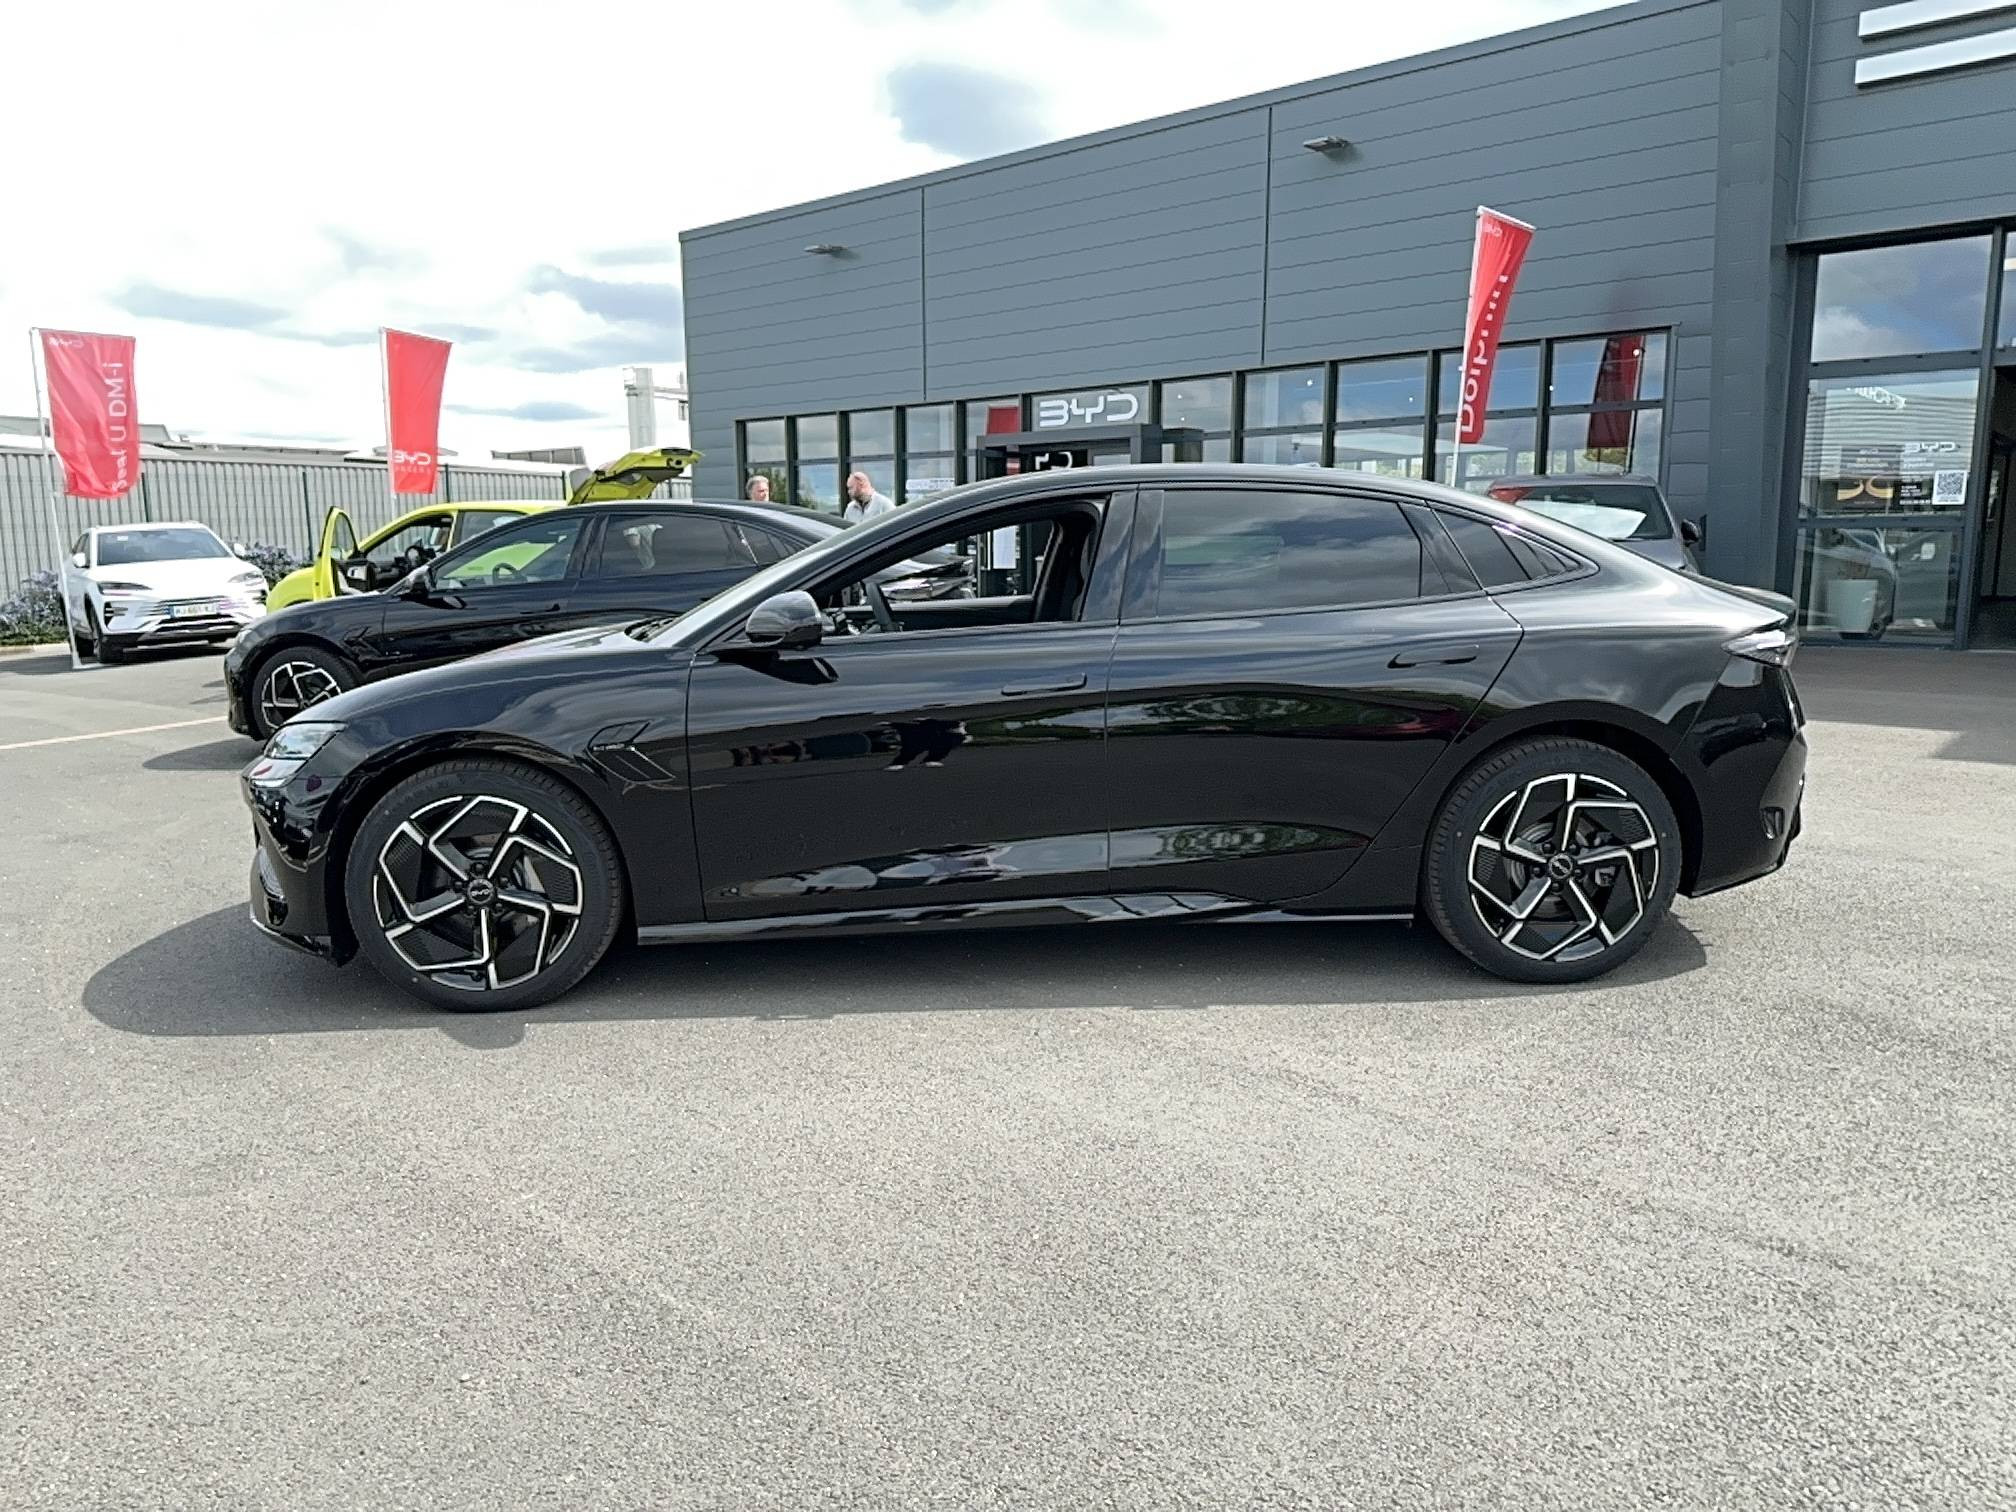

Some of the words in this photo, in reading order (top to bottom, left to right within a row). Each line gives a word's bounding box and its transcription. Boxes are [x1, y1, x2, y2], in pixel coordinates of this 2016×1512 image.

[102, 362, 127, 417] DM-i
[1039, 393, 1139, 427] BYD
[109, 429, 127, 442] U
[1903, 441, 1956, 453] BYD
[392, 449, 432, 465] BYD
[111, 448, 128, 492] Seal
